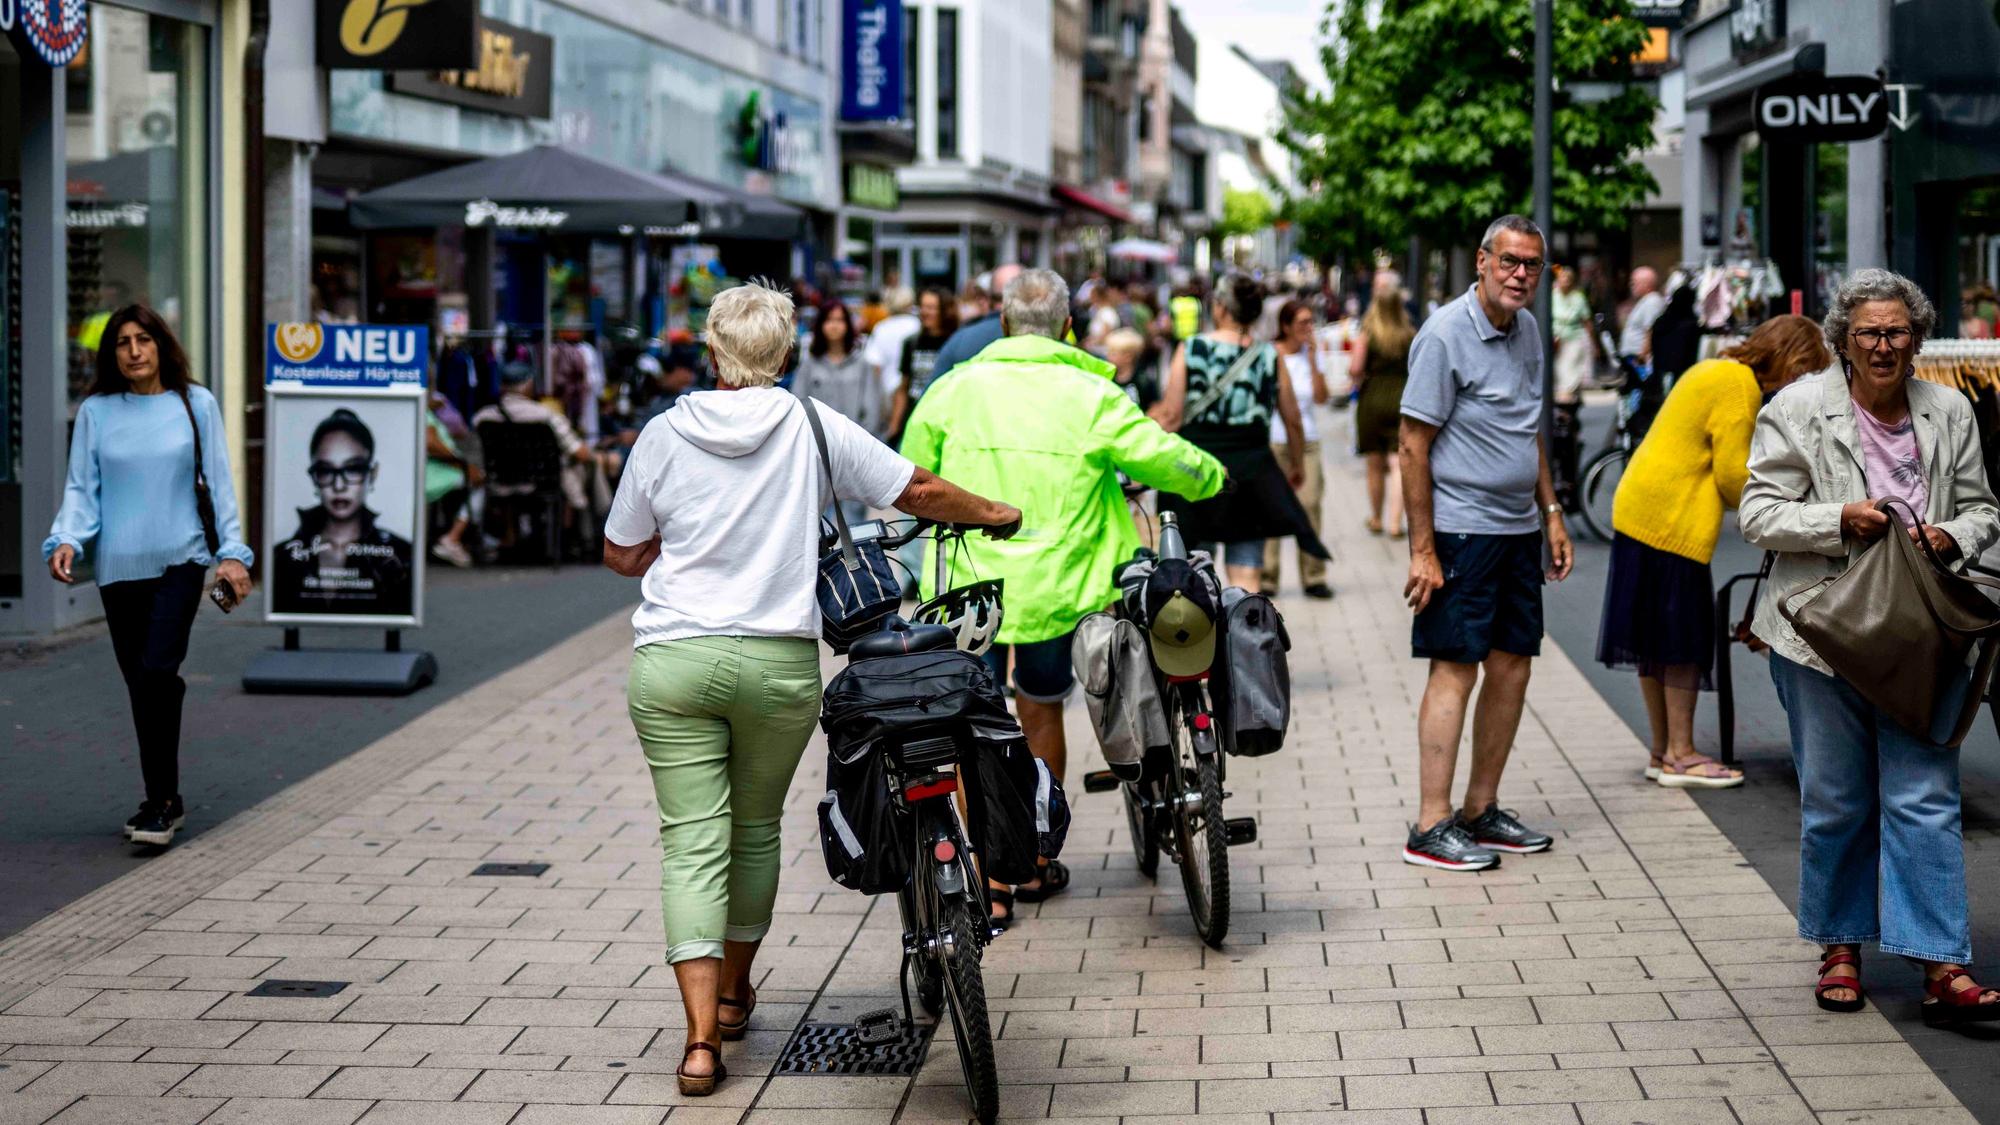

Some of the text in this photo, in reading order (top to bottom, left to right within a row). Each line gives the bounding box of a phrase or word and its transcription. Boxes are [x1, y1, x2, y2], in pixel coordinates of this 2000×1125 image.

[856, 5, 887, 107] Thalia
[1761, 92, 1880, 127] ONLY
[335, 329, 416, 363] NEU
[273, 365, 421, 381] Kostenloser Hörtest
